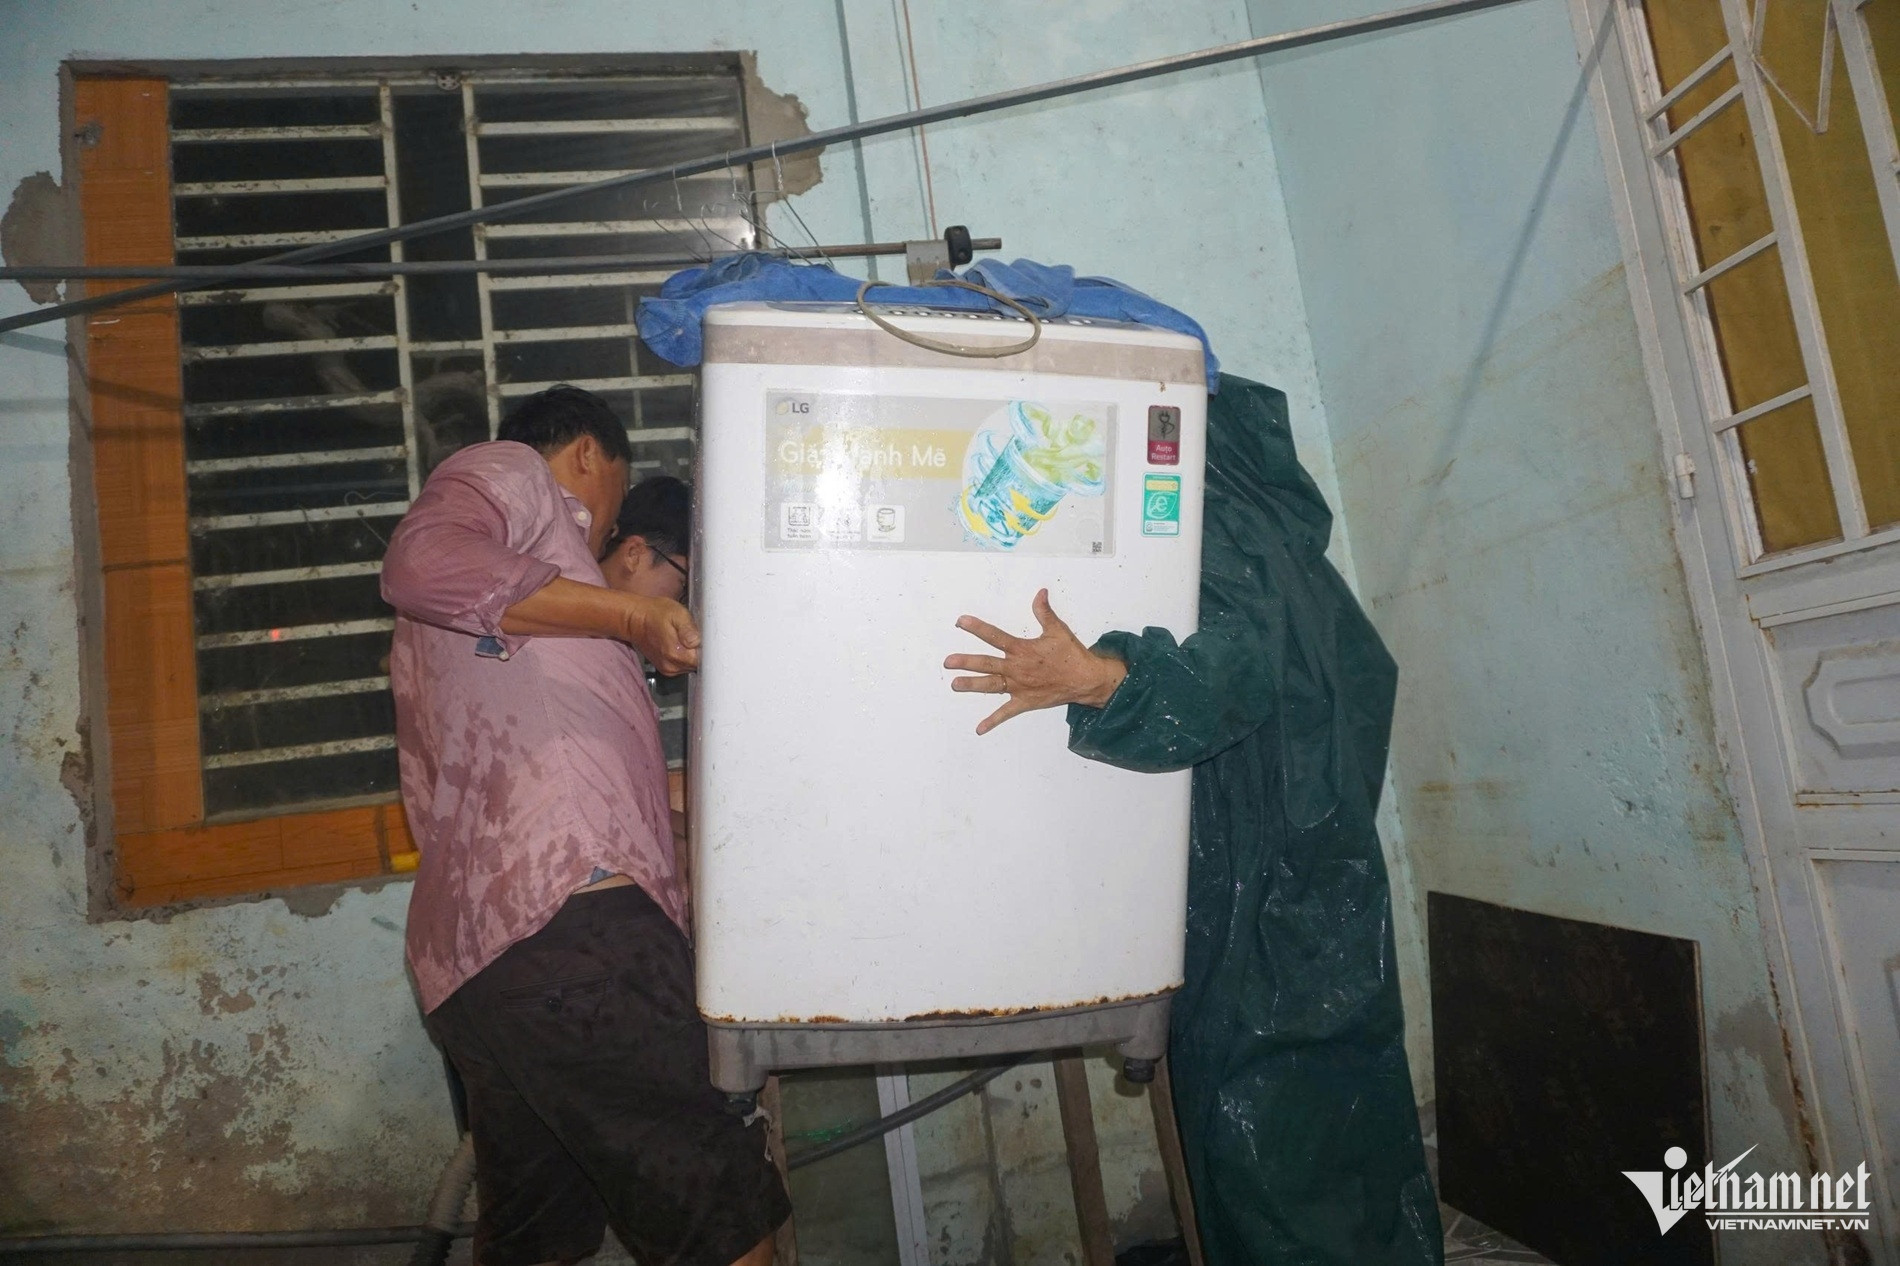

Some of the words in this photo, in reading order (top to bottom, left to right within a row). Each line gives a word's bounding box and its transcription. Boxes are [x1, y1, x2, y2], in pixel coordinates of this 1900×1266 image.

[791, 402, 810, 414] LG
[1155, 444, 1173, 452] Auto
[911, 444, 947, 467] Mẽ
[1151, 452, 1178, 461] Restart
